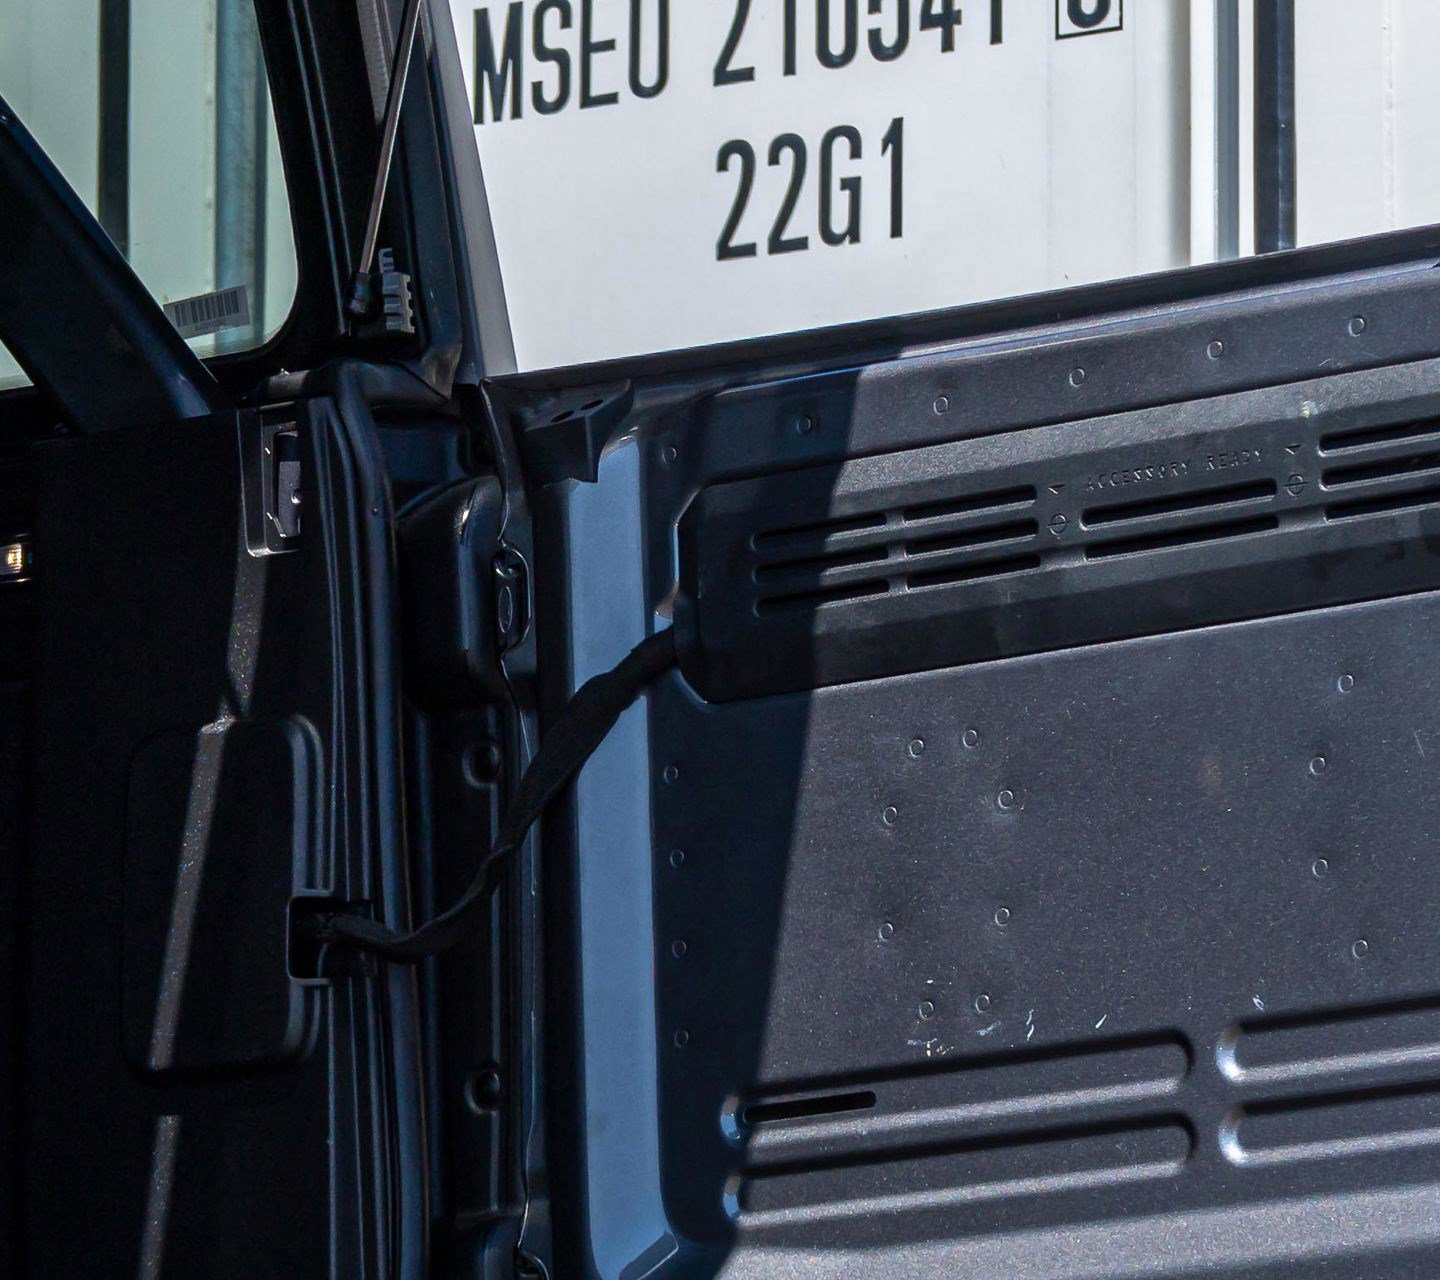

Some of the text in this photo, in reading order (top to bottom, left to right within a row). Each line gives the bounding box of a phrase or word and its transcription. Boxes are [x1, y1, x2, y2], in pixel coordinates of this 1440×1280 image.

[716, 116, 904, 262] 22G1
[1085, 448, 1265, 492] ACCESSORY READY
